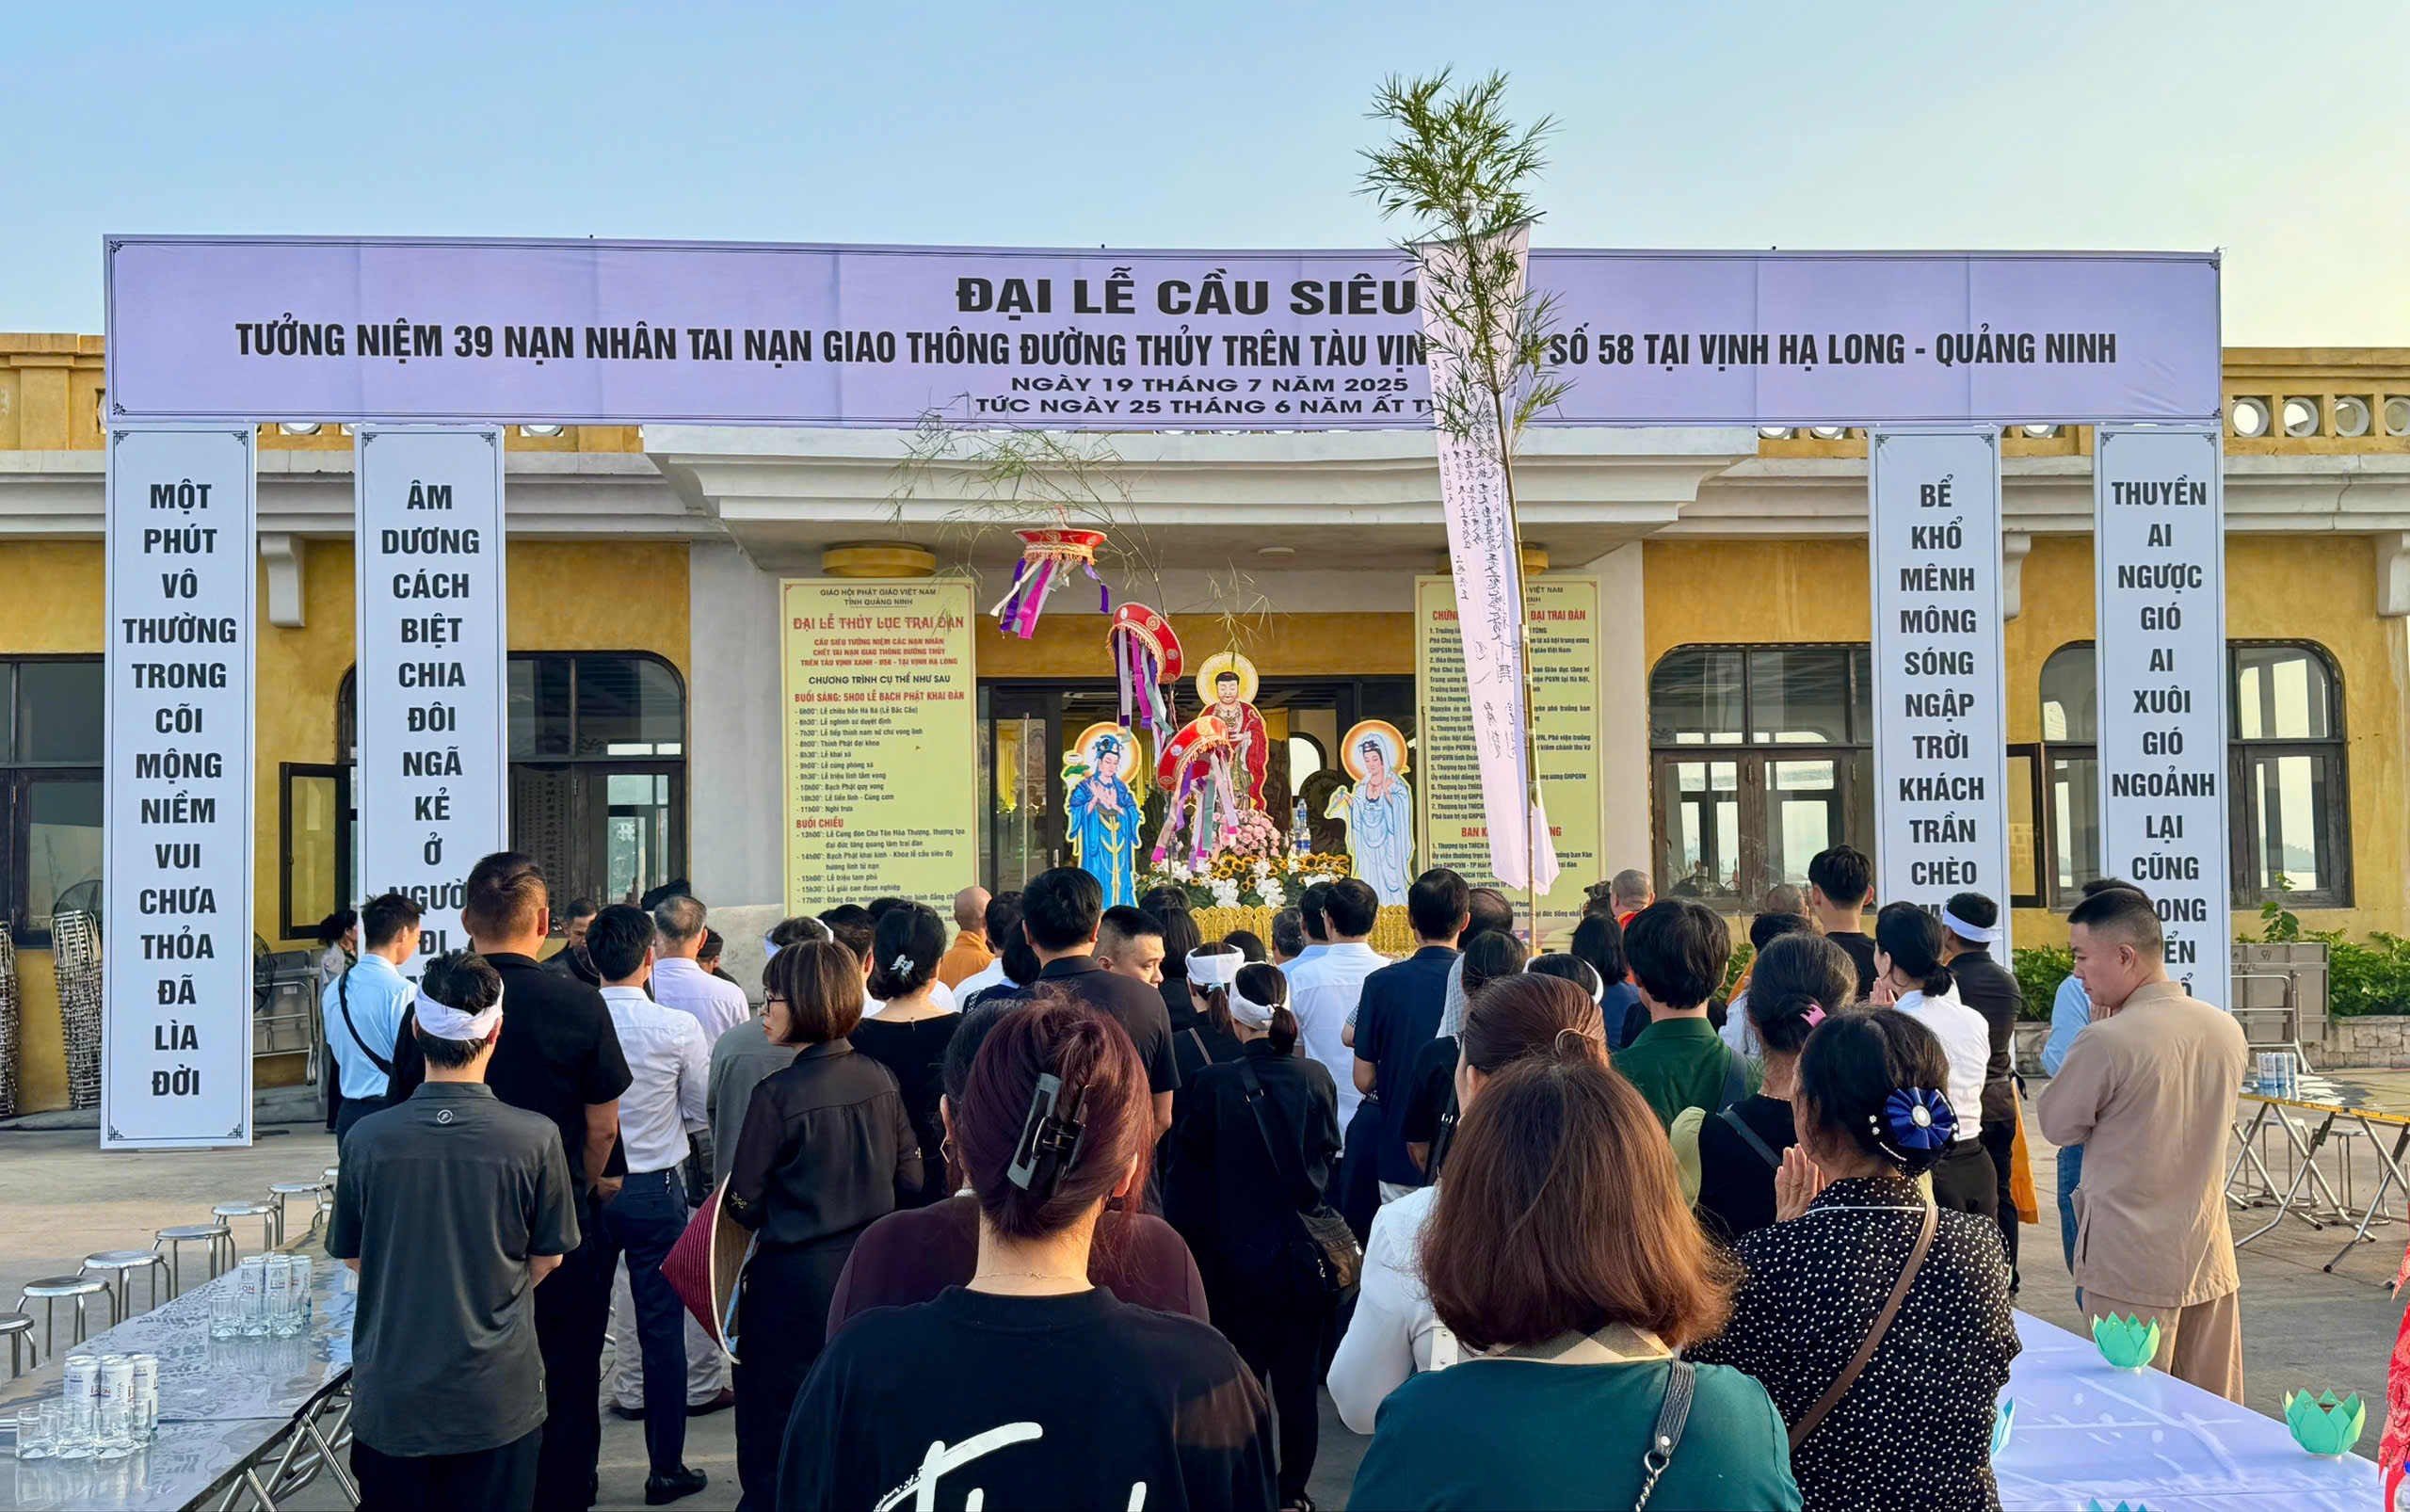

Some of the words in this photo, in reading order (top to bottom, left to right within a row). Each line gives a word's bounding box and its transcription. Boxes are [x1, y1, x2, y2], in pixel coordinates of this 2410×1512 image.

[956, 277, 1051, 320] ĐẠI
[1074, 266, 1135, 314] LỄ
[1158, 267, 1268, 314] CẦU
[1291, 272, 1415, 314] SIÊU
[235, 312, 345, 356] TƯỞNG
[358, 317, 442, 363] NIỆM
[455, 326, 492, 357] 39
[505, 327, 573, 365] NẠN
[586, 320, 676, 360] NHÂN
[687, 329, 732, 360] TAI
[745, 330, 811, 368] NẠN
[824, 330, 895, 362] GIAO
[907, 325, 1009, 364] THÔNG
[1020, 326, 1125, 365] ĐƯỜNG
[1136, 324, 1213, 366] THỦY
[1223, 327, 1299, 366] TRÊN
[1310, 328, 1366, 365] TÀU
[1377, 334, 1426, 372] VỊN
[1550, 323, 1590, 364] SỐ
[1599, 334, 1633, 364] 58
[1645, 334, 1689, 371] TẠI
[1700, 335, 1768, 371] VỊNH
[1780, 335, 1818, 372] HẠ
[1829, 334, 1904, 363] LONG
[1936, 323, 2034, 367] QUẢNG
[2047, 334, 2115, 363] NINH
[1012, 375, 1091, 391] NGÀY
[1103, 378, 1133, 392] 19
[1142, 375, 1238, 392] THÁNG
[1248, 378, 1261, 392] 7
[1273, 375, 1334, 392] NĂM
[1345, 378, 1408, 392] 2025
[976, 395, 1029, 412] TỨC
[1041, 396, 1119, 412] NGÀY
[1130, 400, 1161, 413] 25
[1170, 395, 1265, 413] THÁNG
[1276, 400, 1290, 413] 6
[1301, 396, 1361, 413] NĂM
[1373, 394, 1404, 412] ẤT
[151, 478, 212, 514] MỘT
[407, 480, 452, 509] ÂM
[1920, 475, 1953, 507] BỂ
[2112, 475, 2207, 506] THUYỀN
[144, 523, 217, 554] PHÚT
[381, 526, 479, 555] DƯƠNG
[1912, 516, 1963, 550] KHỔ
[2147, 523, 2172, 547] AI
[162, 569, 198, 599] VÔ
[393, 569, 469, 599] CÁCH
[1900, 563, 1975, 591] MÊNH
[2118, 564, 2202, 593] NGƯỢC
[122, 612, 236, 644] THƯỜNG
[794, 618, 814, 632] ĐẠI
[819, 613, 835, 629] LỄ
[839, 614, 873, 629] THỦY
[905, 617, 933, 630] TRAI
[1531, 610, 1545, 622] ĐẠI
[1548, 610, 1566, 620] TRAI
[1568, 608, 1585, 620] ĐÀN
[1900, 605, 1976, 634] MÔNG
[2141, 603, 2181, 630] GIÓ
[401, 613, 462, 648] BIỆT
[398, 663, 466, 687] CHIA
[1904, 647, 1974, 675] SÓNG
[2149, 649, 2173, 671] AI
[132, 663, 226, 688] TRONG
[809, 675, 848, 684] CHƯƠNG
[851, 674, 876, 684] TRÌNH
[879, 675, 892, 684] CỤ
[894, 673, 909, 683] THỂ
[913, 674, 931, 683] NHƯ
[795, 691, 813, 701] BUỔI
[817, 692, 841, 701] SÁNG:
[867, 690, 876, 700] LỄ
[879, 692, 900, 702] BẠCH
[904, 690, 924, 701] PHẬT
[926, 691, 945, 700] KHAI
[947, 691, 964, 700] ĐÀN
[1905, 688, 1974, 722] NGẬP
[2133, 685, 2191, 714] XUÔI
[155, 703, 202, 733] CÕI
[408, 701, 456, 732] ĐÔI
[1912, 730, 1968, 760] TRỜI
[2143, 727, 2183, 755] GIÓ
[136, 748, 222, 783] MỘNG
[403, 747, 462, 777] NGÃ
[1900, 773, 1984, 801] KHÁCH
[2113, 765, 2215, 797] NGOẢNH
[141, 790, 216, 824] NIỀM
[415, 787, 450, 821] KẺ
[796, 816, 815, 828] BUỔI
[818, 815, 844, 828] CHIỀU
[1461, 828, 1479, 837] BAN
[1909, 811, 1976, 843] TRẦN
[2146, 815, 2183, 844] LẠI
[155, 844, 201, 869] VUI
[424, 832, 442, 865] Ở
[1911, 857, 1977, 885] CHÈO
[2132, 853, 2199, 881] CŨNG
[139, 886, 217, 914] CHƯA
[389, 878, 467, 910] GƯỜ
[2156, 898, 2207, 922] ONG
[141, 925, 215, 959] THỎA
[2163, 930, 2195, 964] ỂN
[158, 974, 196, 1005] ĐÃ
[154, 1020, 199, 1051] LÌA
[153, 1064, 200, 1096] ĐỜI
